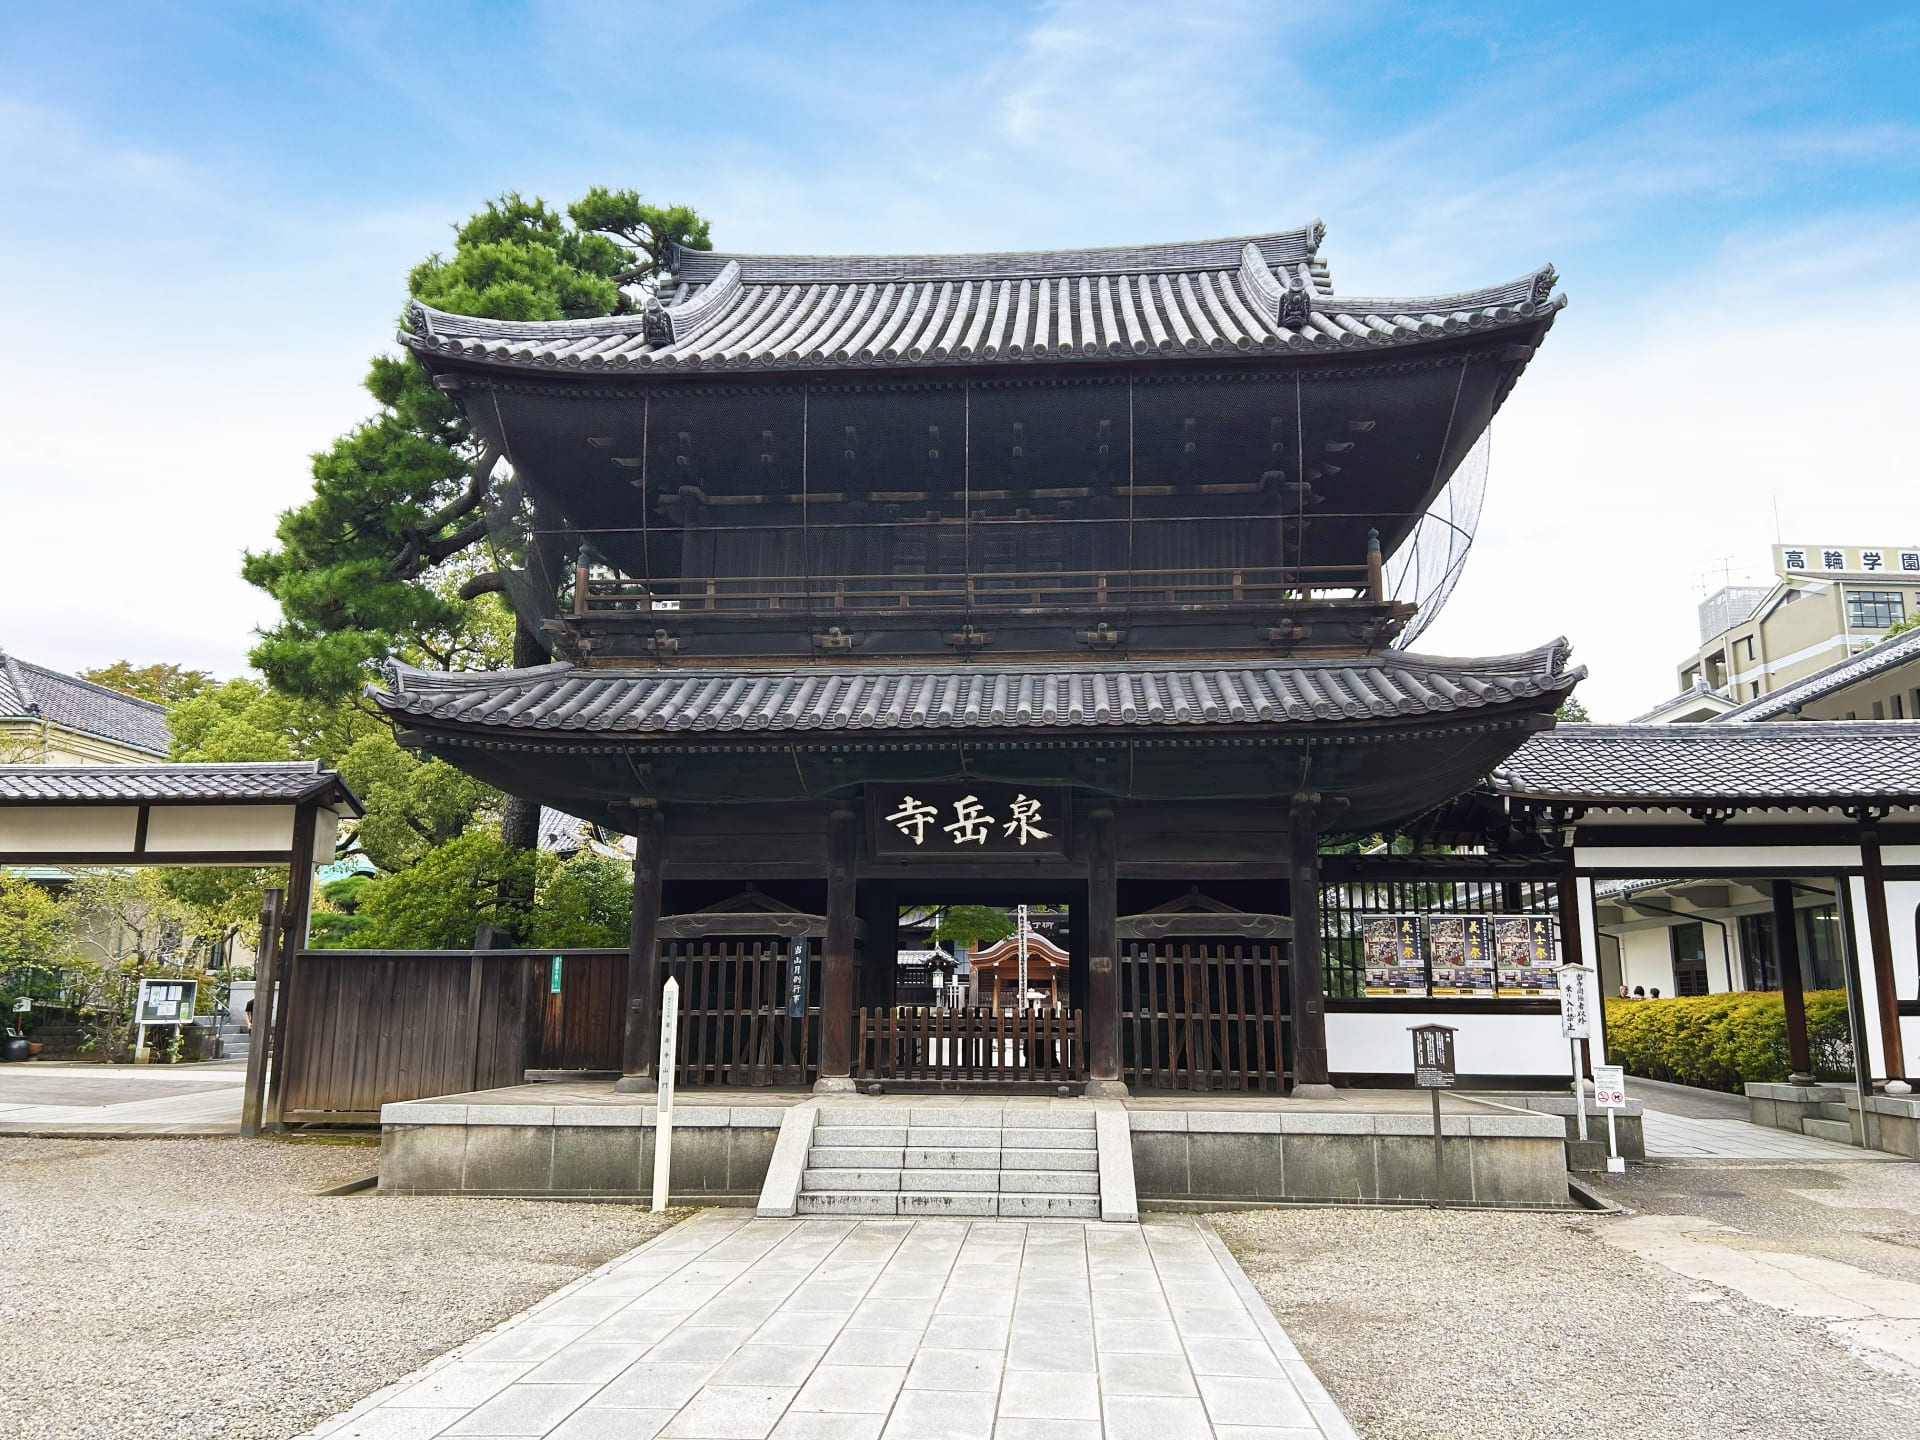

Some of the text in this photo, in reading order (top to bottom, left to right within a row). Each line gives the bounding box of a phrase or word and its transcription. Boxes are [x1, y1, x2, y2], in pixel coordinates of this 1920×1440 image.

[1784, 550, 1920, 571] 高輪学園
[1401, 920, 1415, 959] 義士祭
[1468, 921, 1482, 959] 義士祭
[1533, 921, 1548, 960] 義士祭
